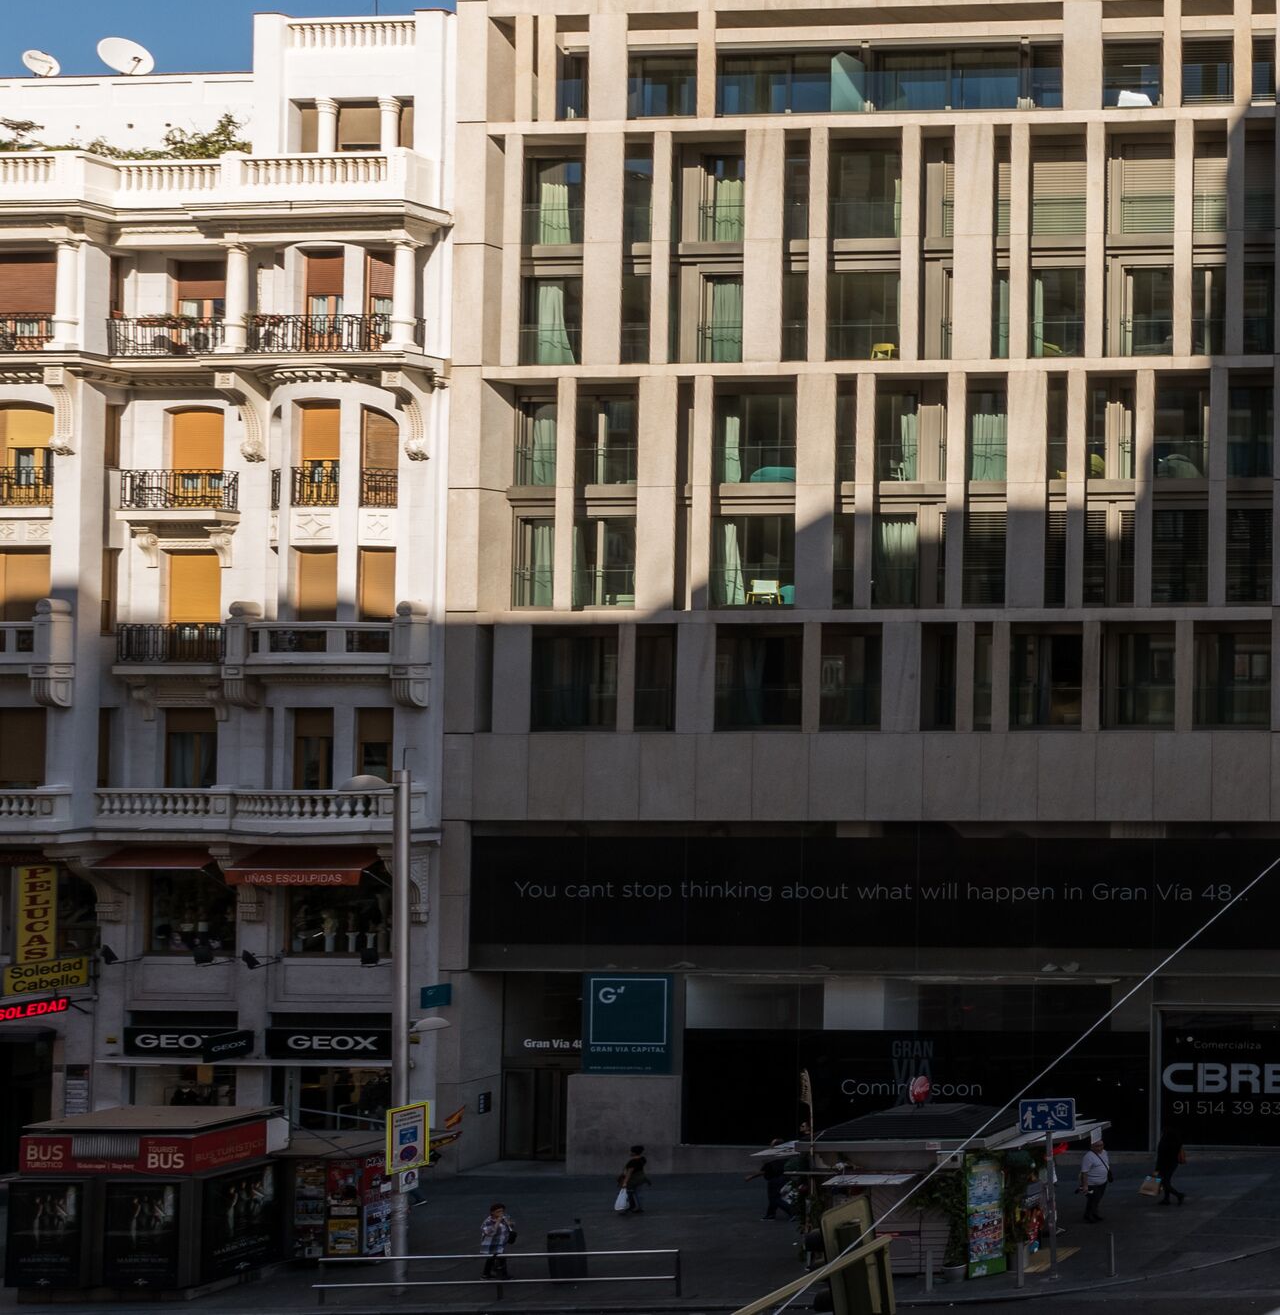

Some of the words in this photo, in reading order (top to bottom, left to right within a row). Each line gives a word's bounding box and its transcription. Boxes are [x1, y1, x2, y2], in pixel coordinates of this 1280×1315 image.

[244, 872, 274, 884] UÑAS
[275, 873, 342, 884] ESCULPIDAS
[514, 881, 556, 899] You
[564, 881, 614, 899] cant
[622, 881, 672, 902] stop
[680, 880, 772, 902] thinking
[780, 881, 849, 900] about
[857, 881, 913, 900] what
[921, 881, 959, 900] will
[967, 882, 1055, 903] happen
[1064, 882, 1083, 900] in
[1092, 883, 1147, 901] Gran
[1155, 882, 1193, 901] Vía
[24, 867, 51, 962] PELUCAS
[10, 959, 83, 980] Soledad
[12, 973, 80, 993] Cabello
[0, 998, 67, 1022] SOLEDAD
[135, 1034, 208, 1049] GEO
[211, 1038, 248, 1054] GEOX
[287, 1035, 379, 1051] GEOX
[523, 1038, 550, 1049] Gran
[891, 1039, 934, 1059] GRAN
[1193, 1040, 1262, 1051] Comercializa
[841, 1079, 910, 1096] Comin
[931, 1083, 983, 1096] soon
[1172, 1100, 1190, 1116] 91
[1195, 1100, 1225, 1116] 514
[1231, 1100, 1254, 1116] 39
[26, 1144, 64, 1161] BUS
[147, 1153, 185, 1169] BUS
